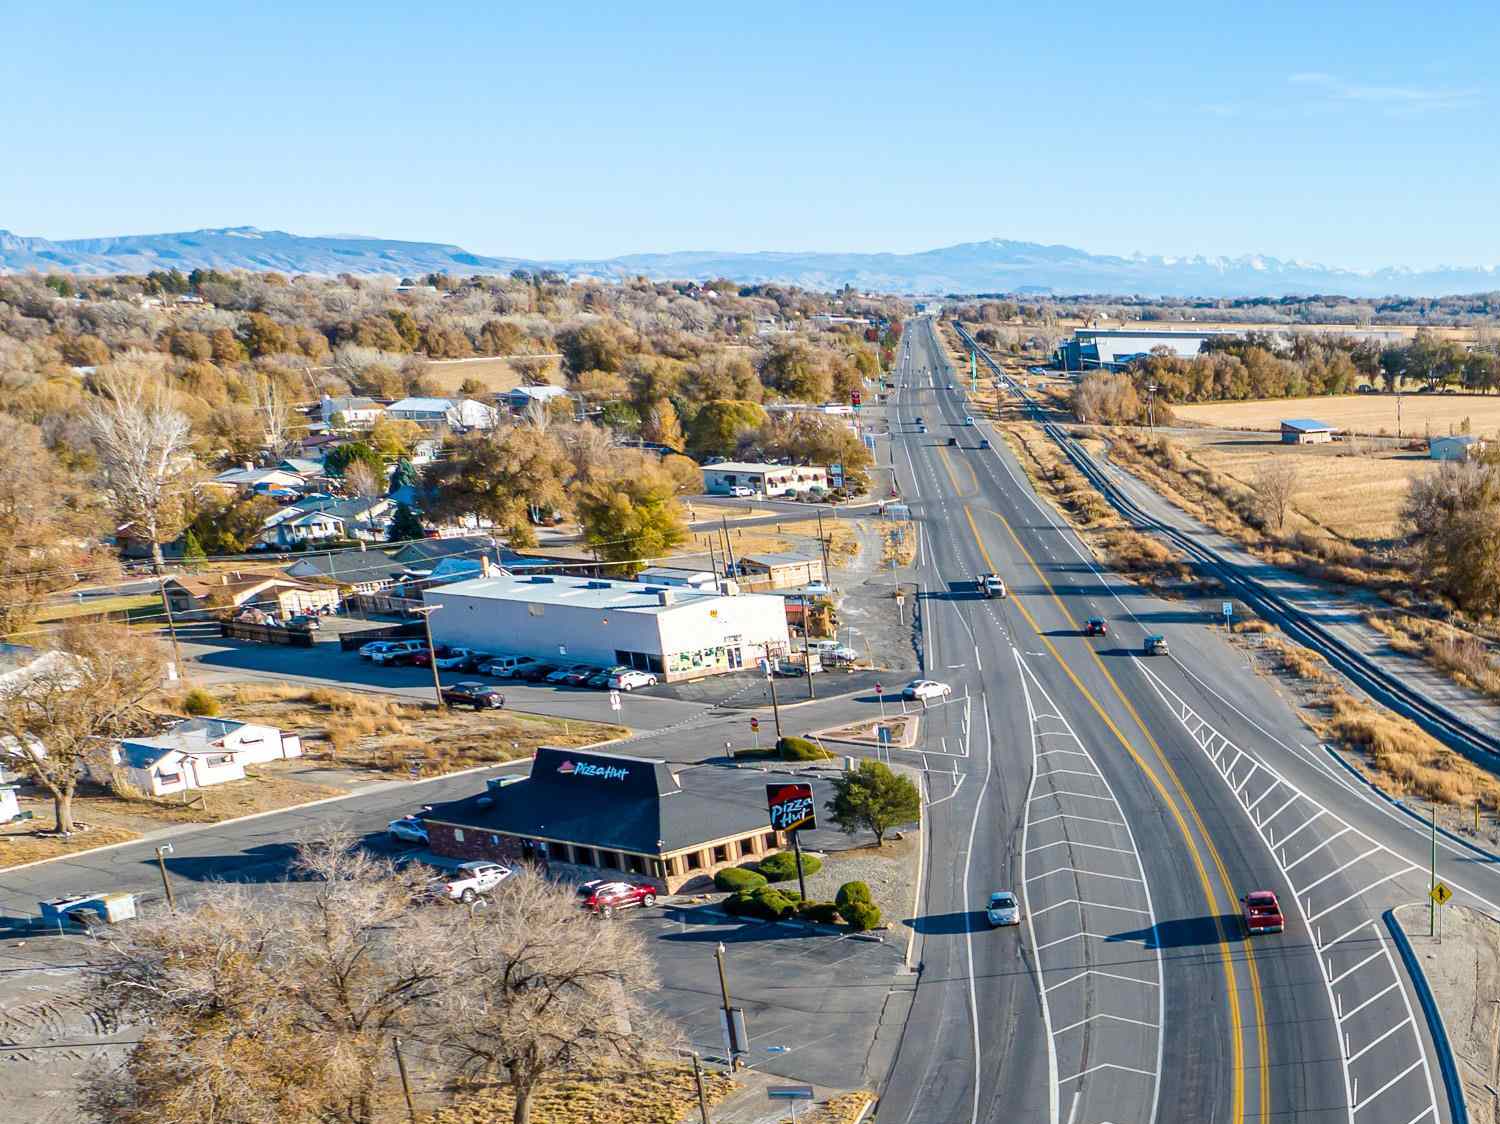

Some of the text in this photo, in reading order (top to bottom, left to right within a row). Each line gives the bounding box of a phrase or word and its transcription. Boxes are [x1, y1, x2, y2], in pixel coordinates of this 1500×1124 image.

[574, 761, 630, 781] Pizza Hut
[771, 797, 813, 827] Pizza Hut
